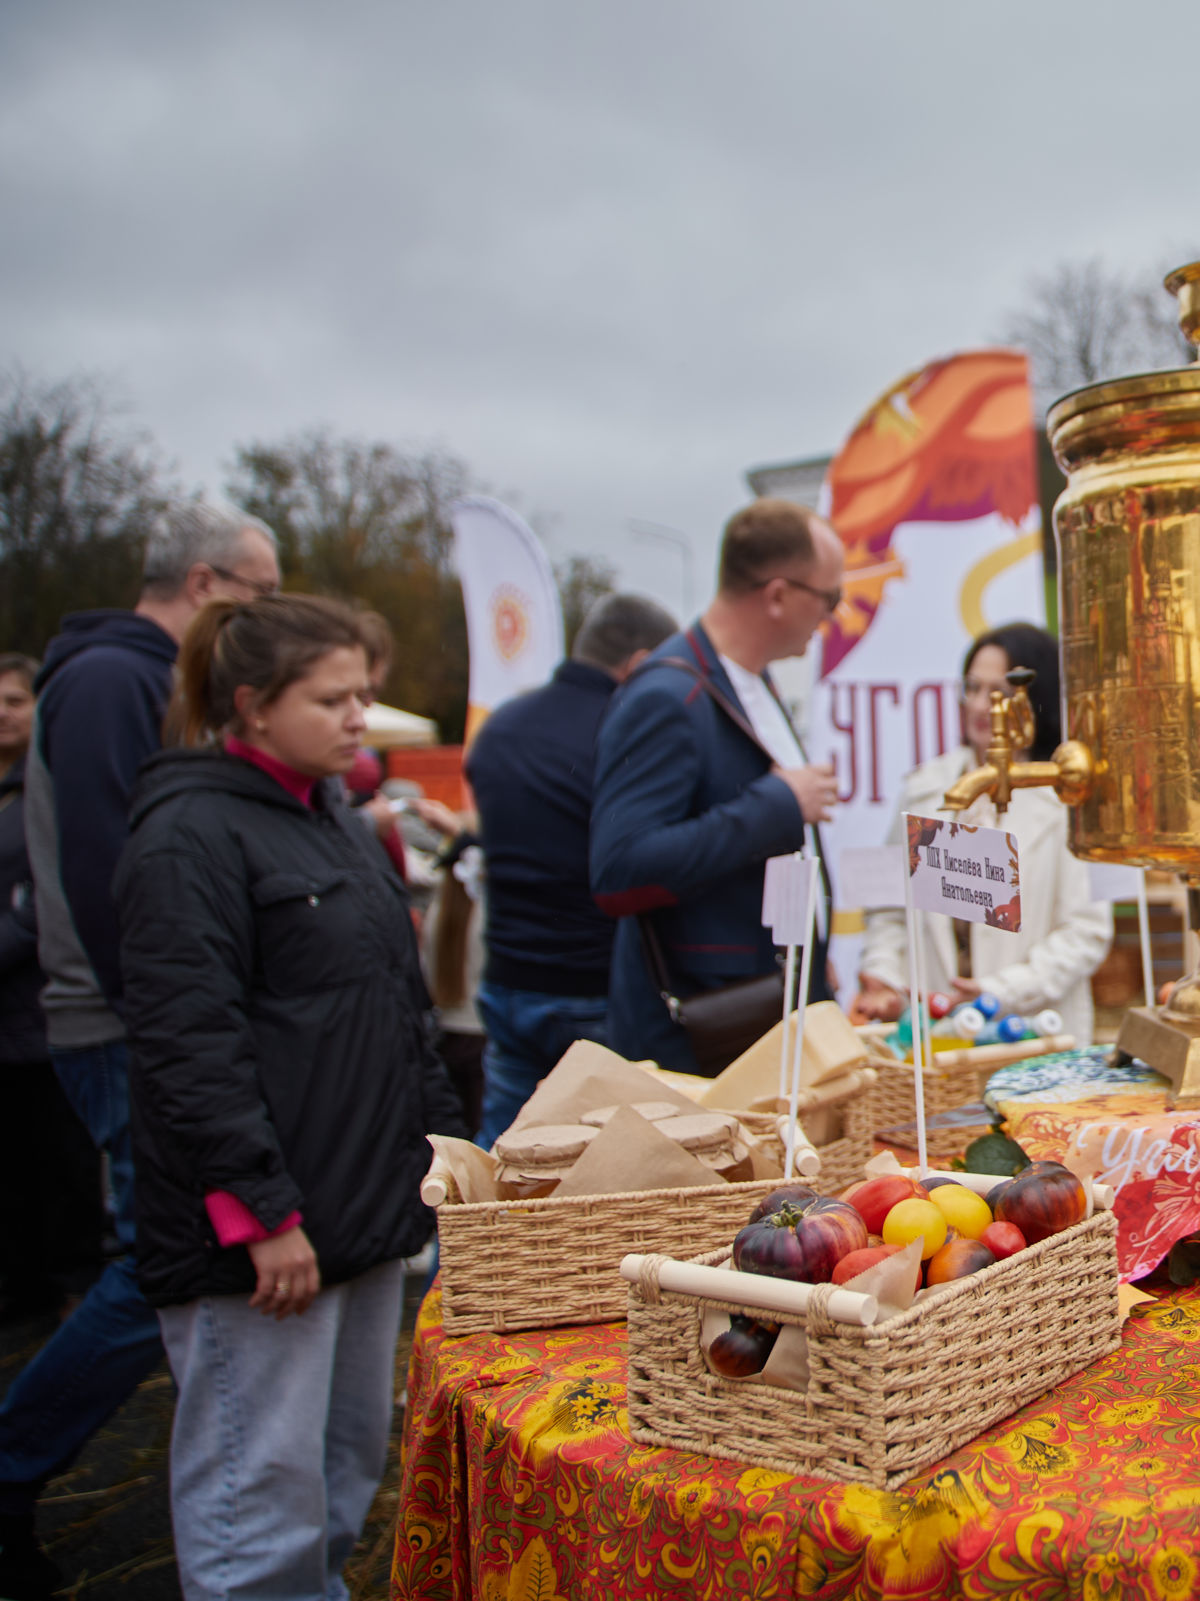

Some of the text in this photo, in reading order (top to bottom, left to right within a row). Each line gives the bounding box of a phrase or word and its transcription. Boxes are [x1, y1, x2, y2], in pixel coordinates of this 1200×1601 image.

[830, 683, 967, 803] УГЛ
[944, 849, 982, 878] Киселёва
[984, 857, 1005, 883] Нина
[941, 876, 993, 908] Анатольевна
